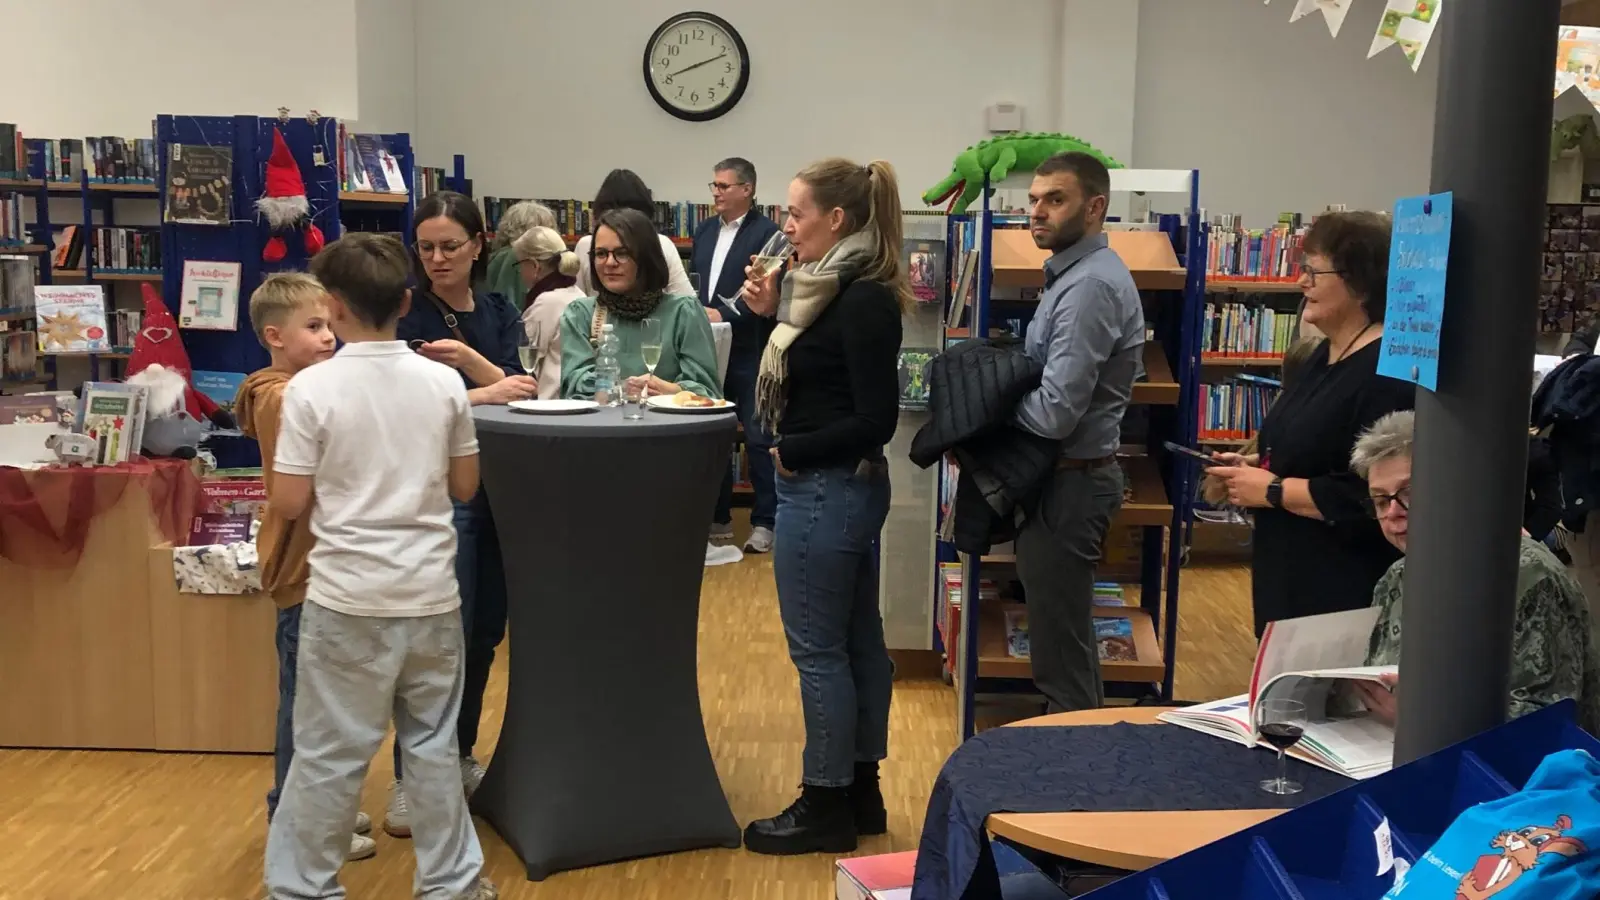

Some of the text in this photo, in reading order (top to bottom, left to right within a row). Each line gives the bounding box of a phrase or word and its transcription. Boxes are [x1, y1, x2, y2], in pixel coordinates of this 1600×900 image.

[679, 33, 688, 45] 11
[692, 29, 704, 40] 12
[667, 44, 680, 56] 10
[720, 45, 727, 56] 2
[661, 58, 670, 69] 9
[724, 62, 732, 73] 3
[665, 73, 673, 85] 8
[717, 77, 726, 88] 4
[677, 86, 685, 97] 7
[690, 90, 699, 102] 6
[707, 87, 715, 99] 5
[244, 487, 267, 497] Gart
